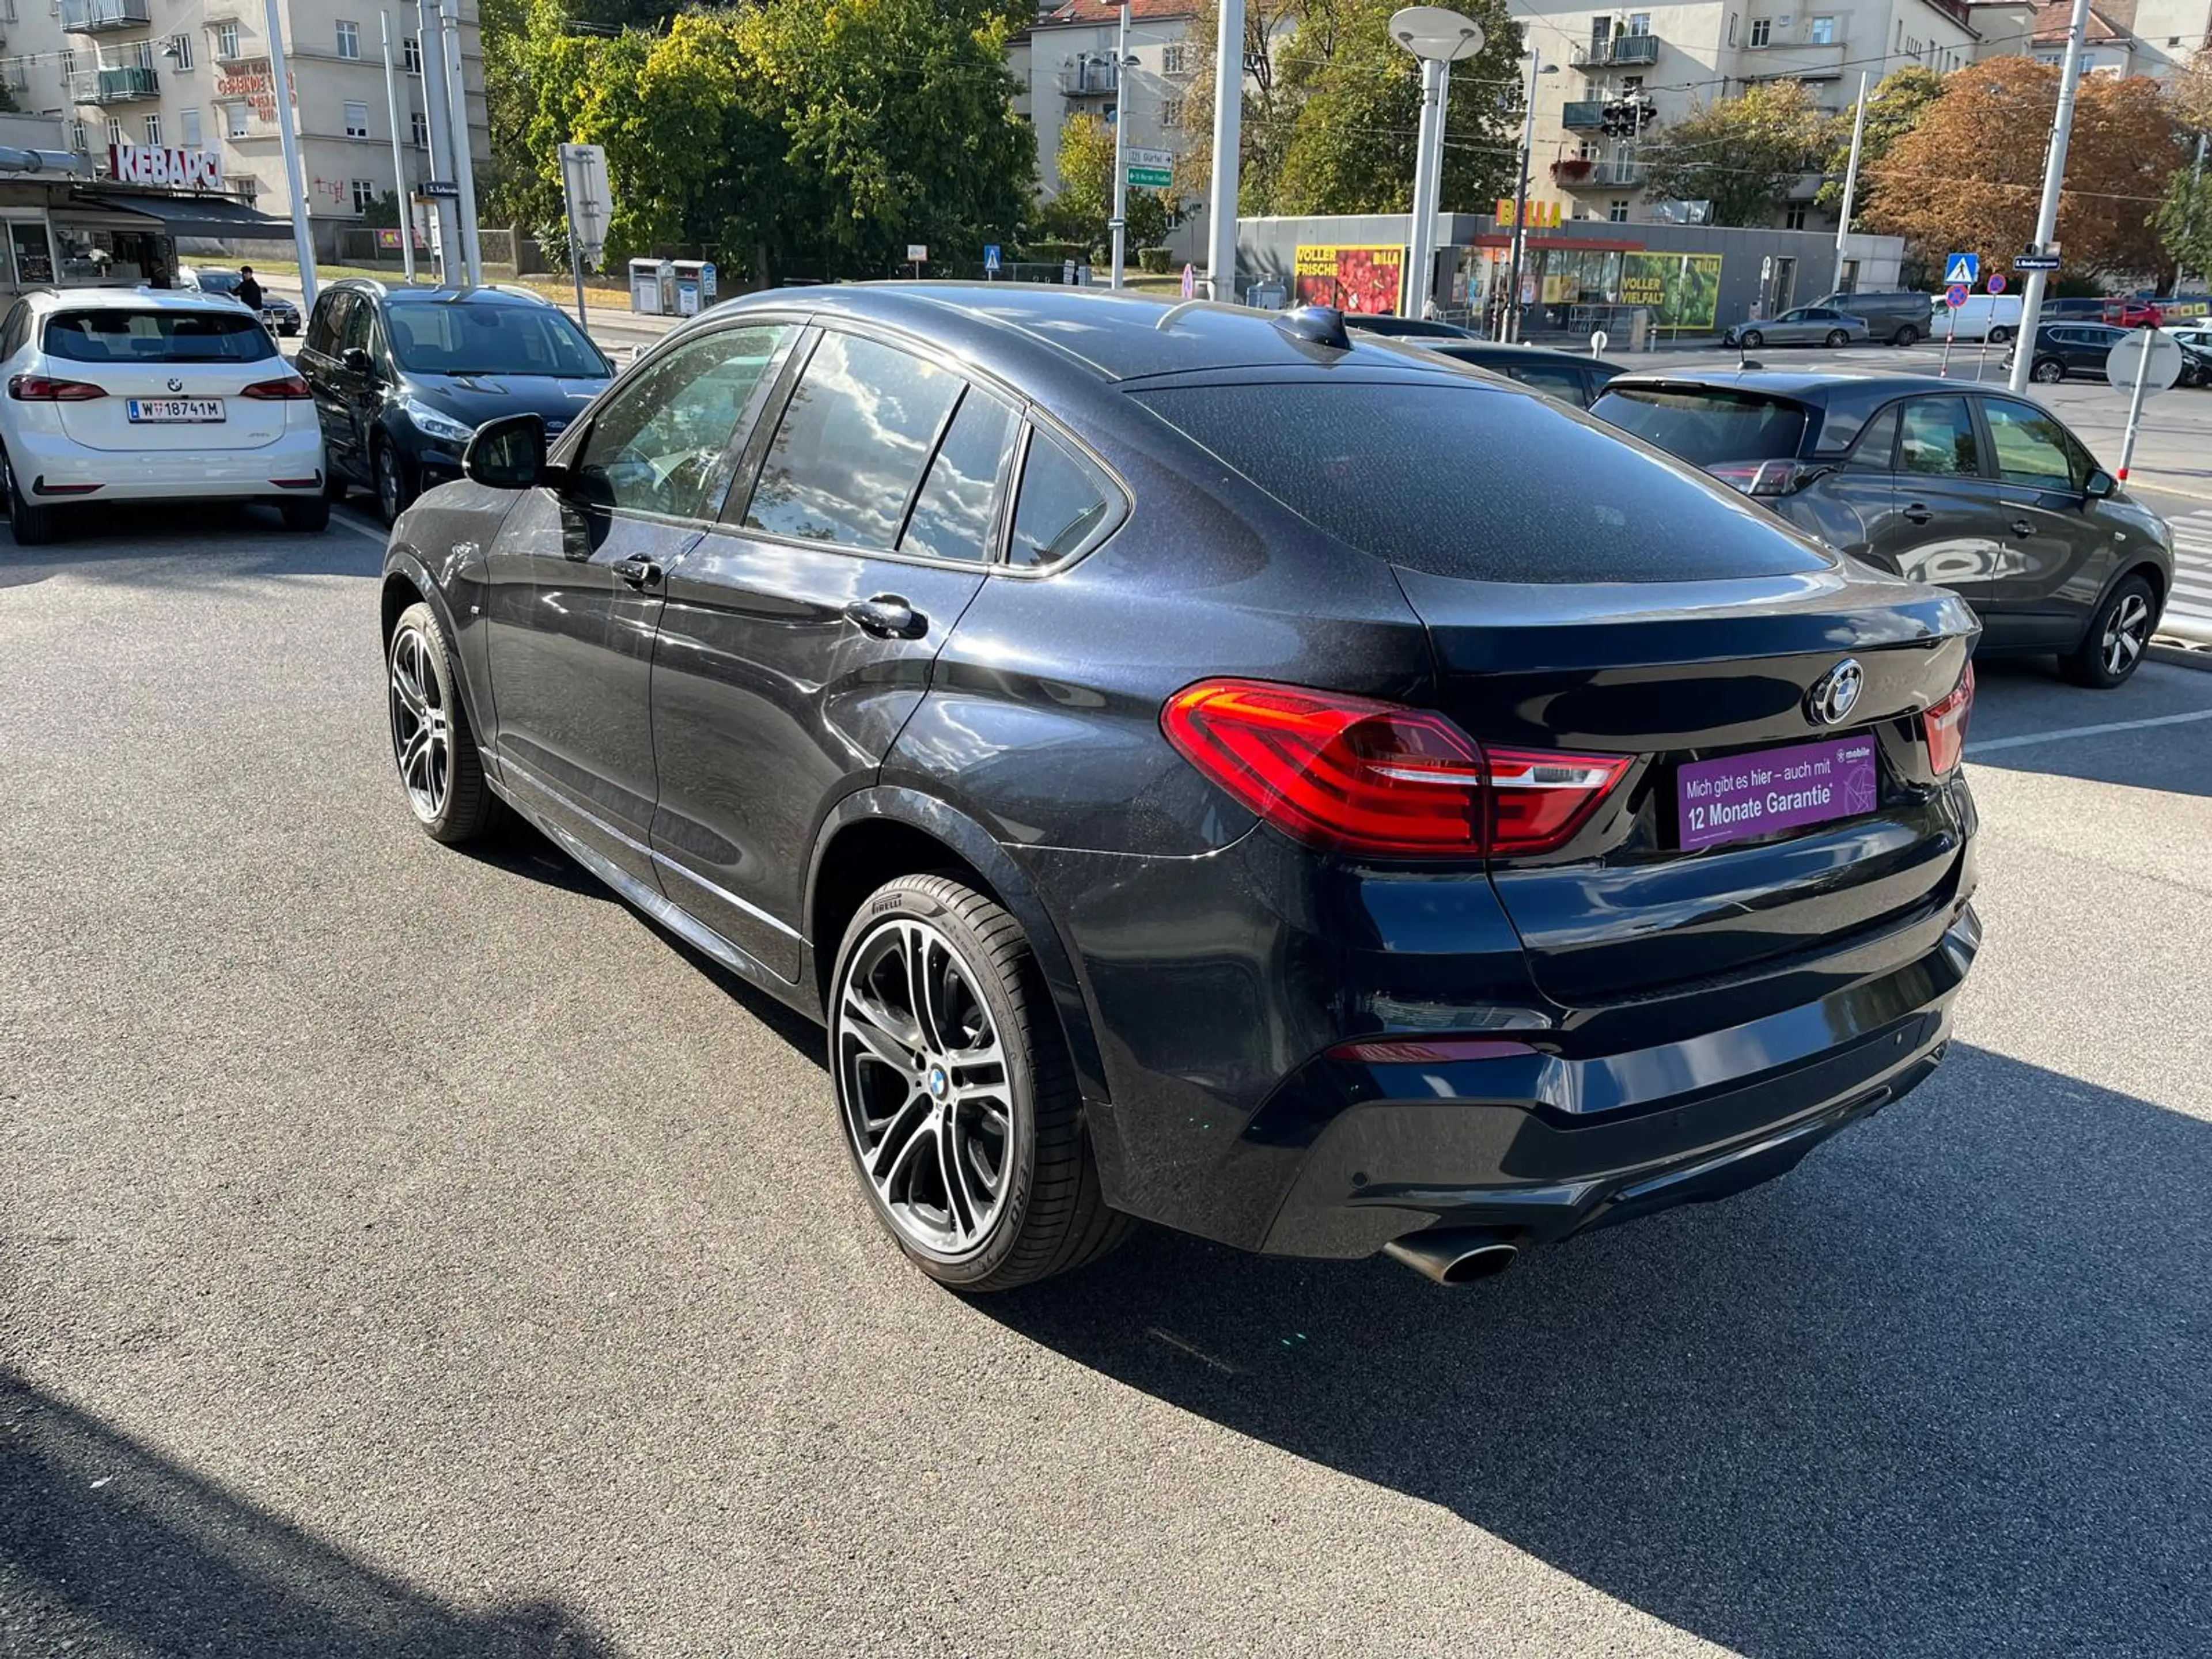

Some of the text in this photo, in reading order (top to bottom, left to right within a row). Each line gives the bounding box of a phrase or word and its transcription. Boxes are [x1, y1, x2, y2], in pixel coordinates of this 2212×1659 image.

[1497, 198, 1561, 229] BLLA
[1297, 249, 1336, 262] VOLLER
[1373, 251, 1399, 266] BILLA
[1296, 263, 1339, 276] FRISCHE
[1624, 277, 1661, 290] VOLLER
[1622, 291, 1665, 305] VIELFALT
[142, 403, 153, 416] W
[165, 402, 218, 416] 18741M
[1846, 746, 1870, 759] mobile
[1687, 777, 1713, 800] Mich
[1714, 775, 1734, 798] gibt
[1736, 777, 1748, 790] es
[1751, 770, 1772, 786] hier
[1784, 761, 1812, 781] auch
[1814, 759, 1831, 775] mit
[1688, 807, 1705, 831] 12
[1710, 800, 1762, 827] Monate
[872, 893, 903, 915] PIRELLI
